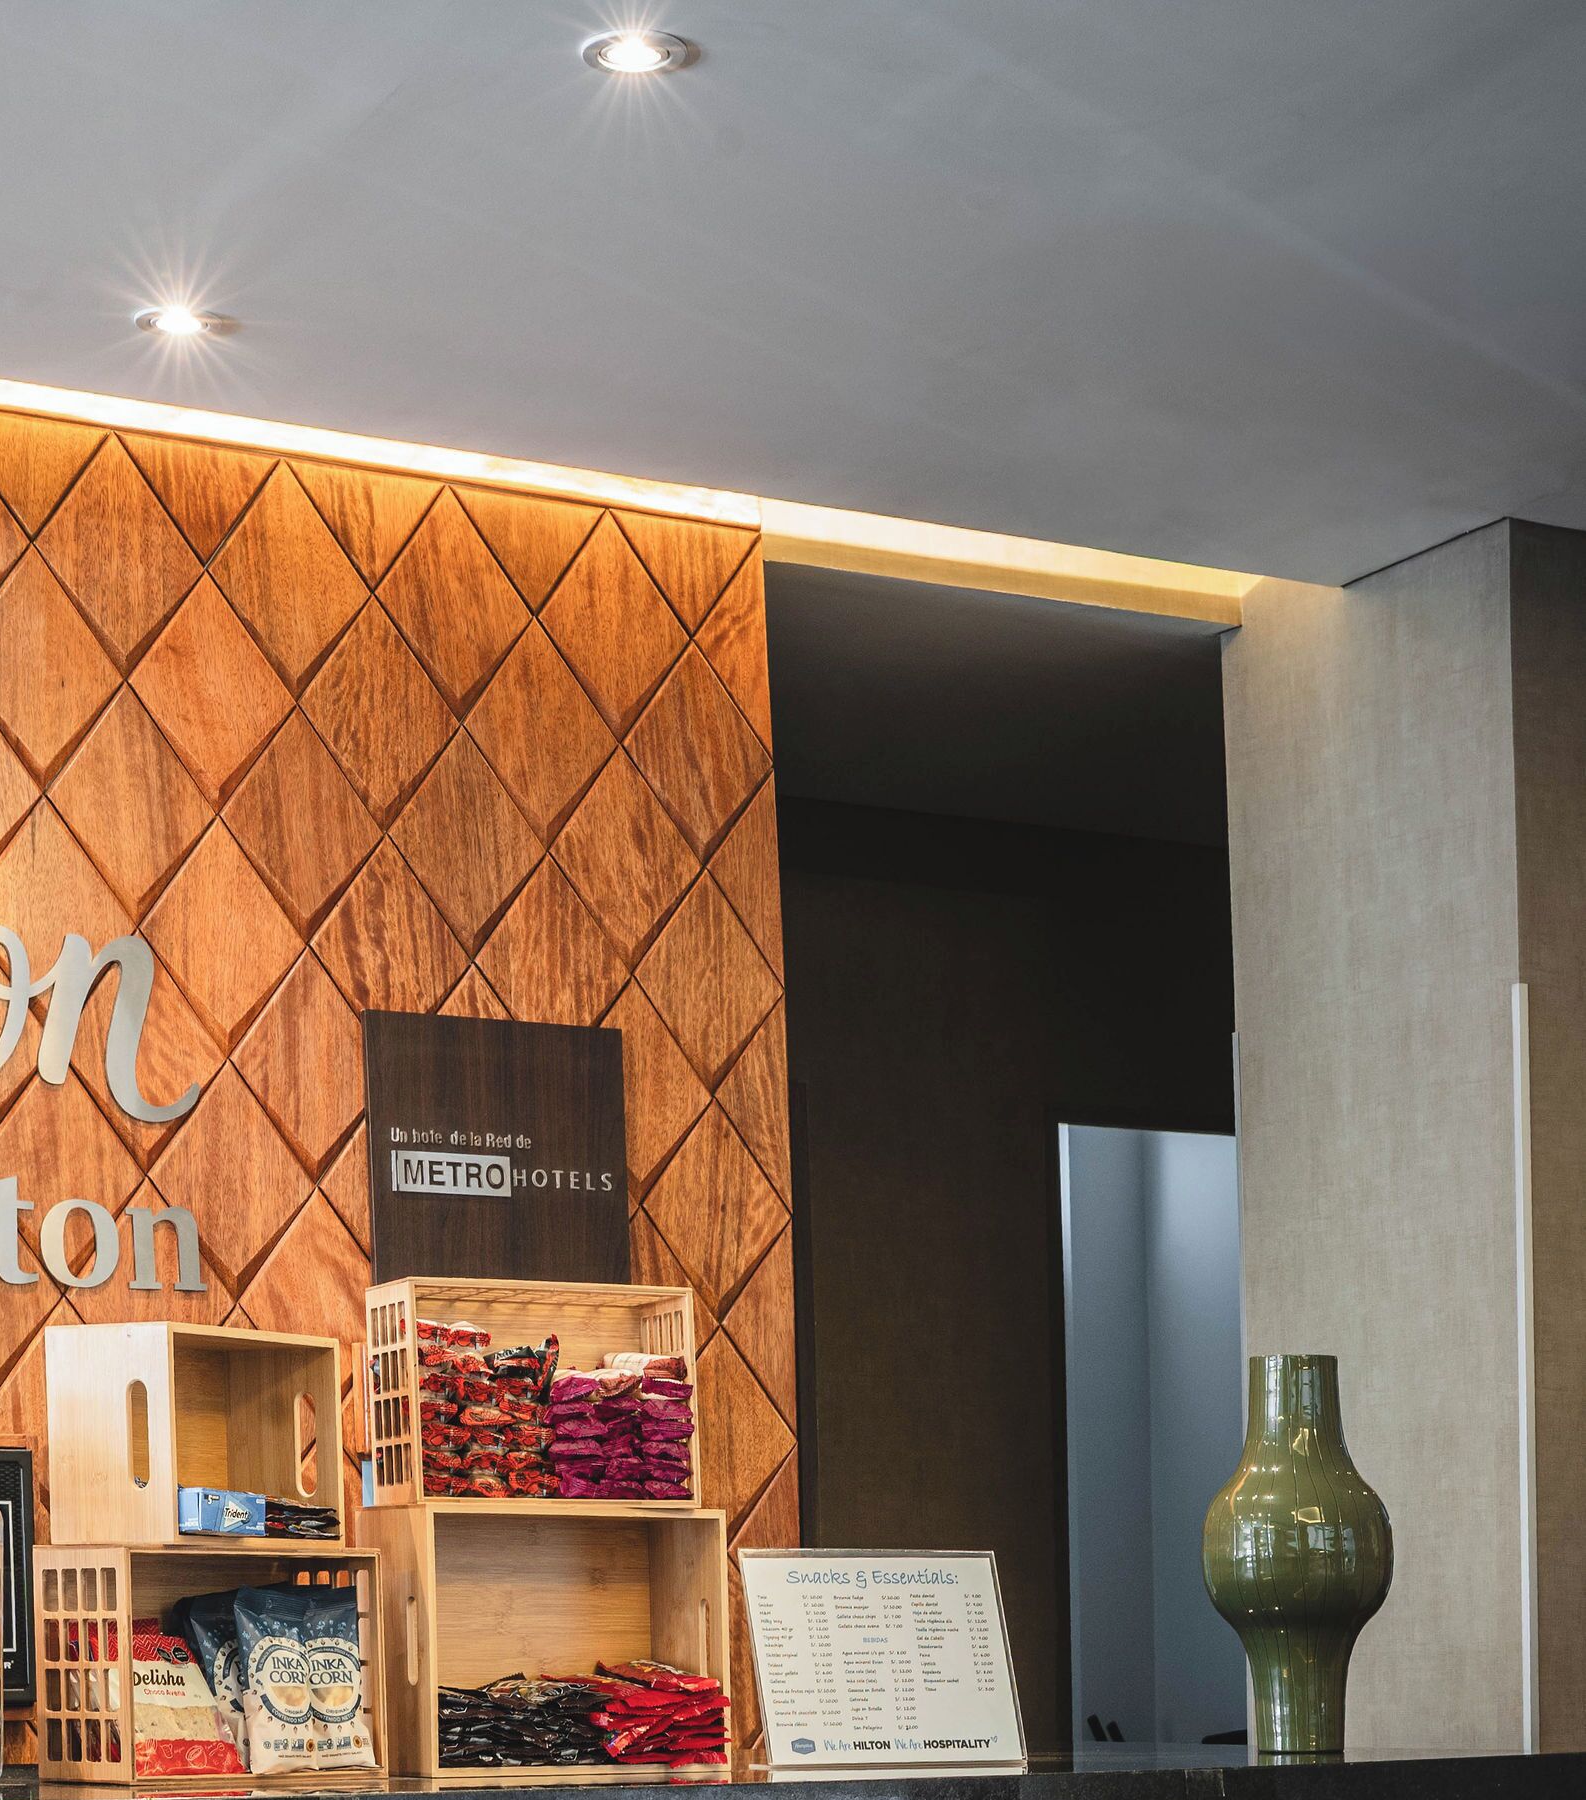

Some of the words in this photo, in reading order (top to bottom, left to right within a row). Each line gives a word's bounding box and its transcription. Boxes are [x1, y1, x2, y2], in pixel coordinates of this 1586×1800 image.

[391, 1127, 408, 1143] Un
[450, 1131, 467, 1146] de
[470, 1132, 482, 1147] la
[486, 1133, 512, 1149] Red
[516, 1134, 532, 1149] de
[404, 1159, 505, 1190] METRO
[513, 1168, 613, 1192] HOTELS
[224, 1507, 249, 1520] Trident
[786, 1567, 851, 1585] Snacks
[855, 1570, 868, 1588] &
[872, 1567, 959, 1585] Essentials:
[271, 1656, 305, 1670] INKA
[311, 1659, 347, 1671] INKA
[133, 1669, 186, 1686] Delisha
[310, 1671, 353, 1685] CORN
[853, 1740, 891, 1751] HILTON
[923, 1739, 991, 1750] HOSPITALITY
